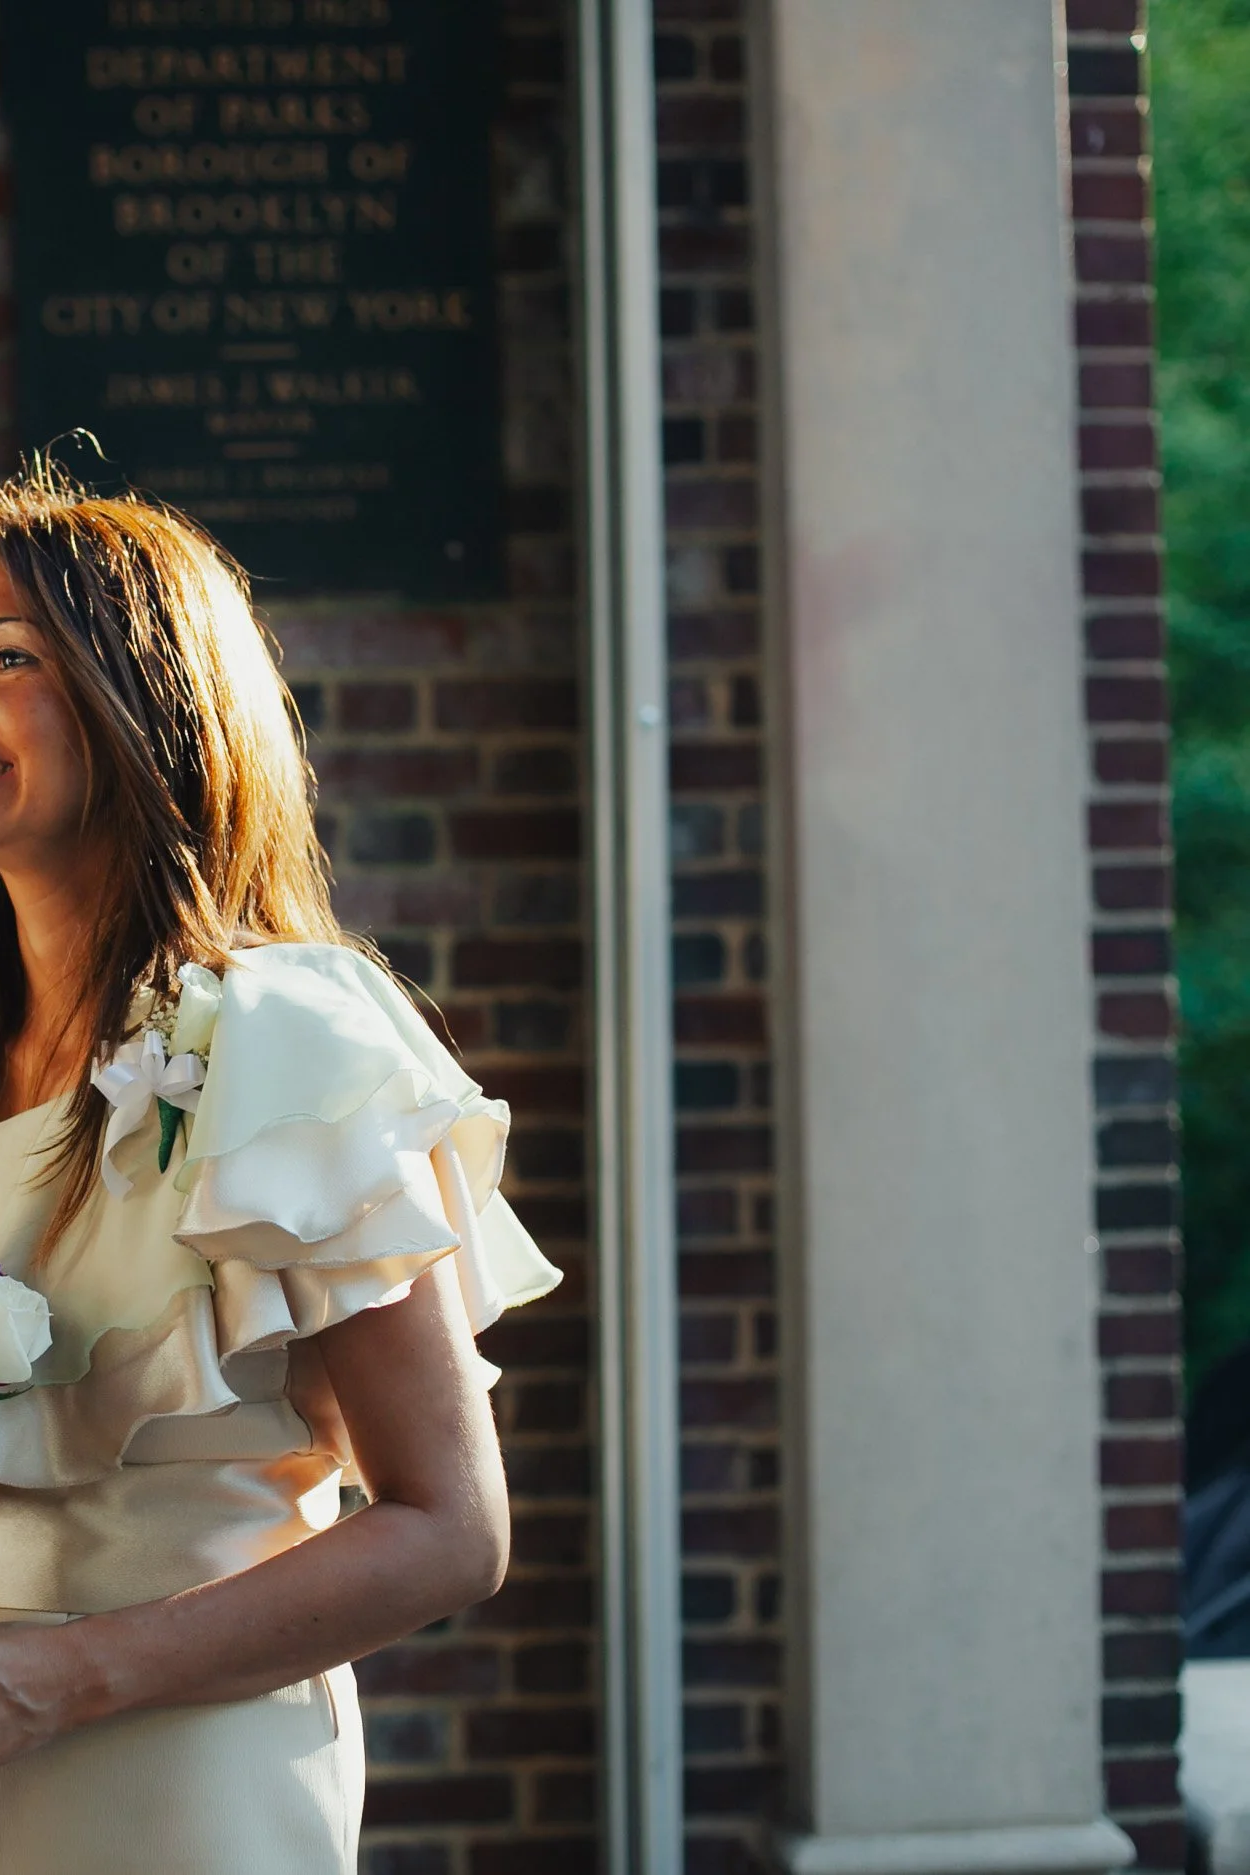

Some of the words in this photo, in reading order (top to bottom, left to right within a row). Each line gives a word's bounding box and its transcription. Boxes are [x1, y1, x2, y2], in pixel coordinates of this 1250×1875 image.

[87, 45, 405, 86] DEPARTMENT
[135, 95, 195, 134] OF
[219, 94, 371, 133] PARKS
[90, 143, 328, 184] BOROUGH
[349, 142, 409, 182] OF
[114, 193, 396, 234] BROOKLYN
[166, 241, 228, 283] OF
[254, 240, 339, 281] THE
[41, 293, 143, 333] CITY
[152, 292, 212, 332] OF
[224, 292, 337, 331] NEW
[348, 289, 472, 331] YORK
